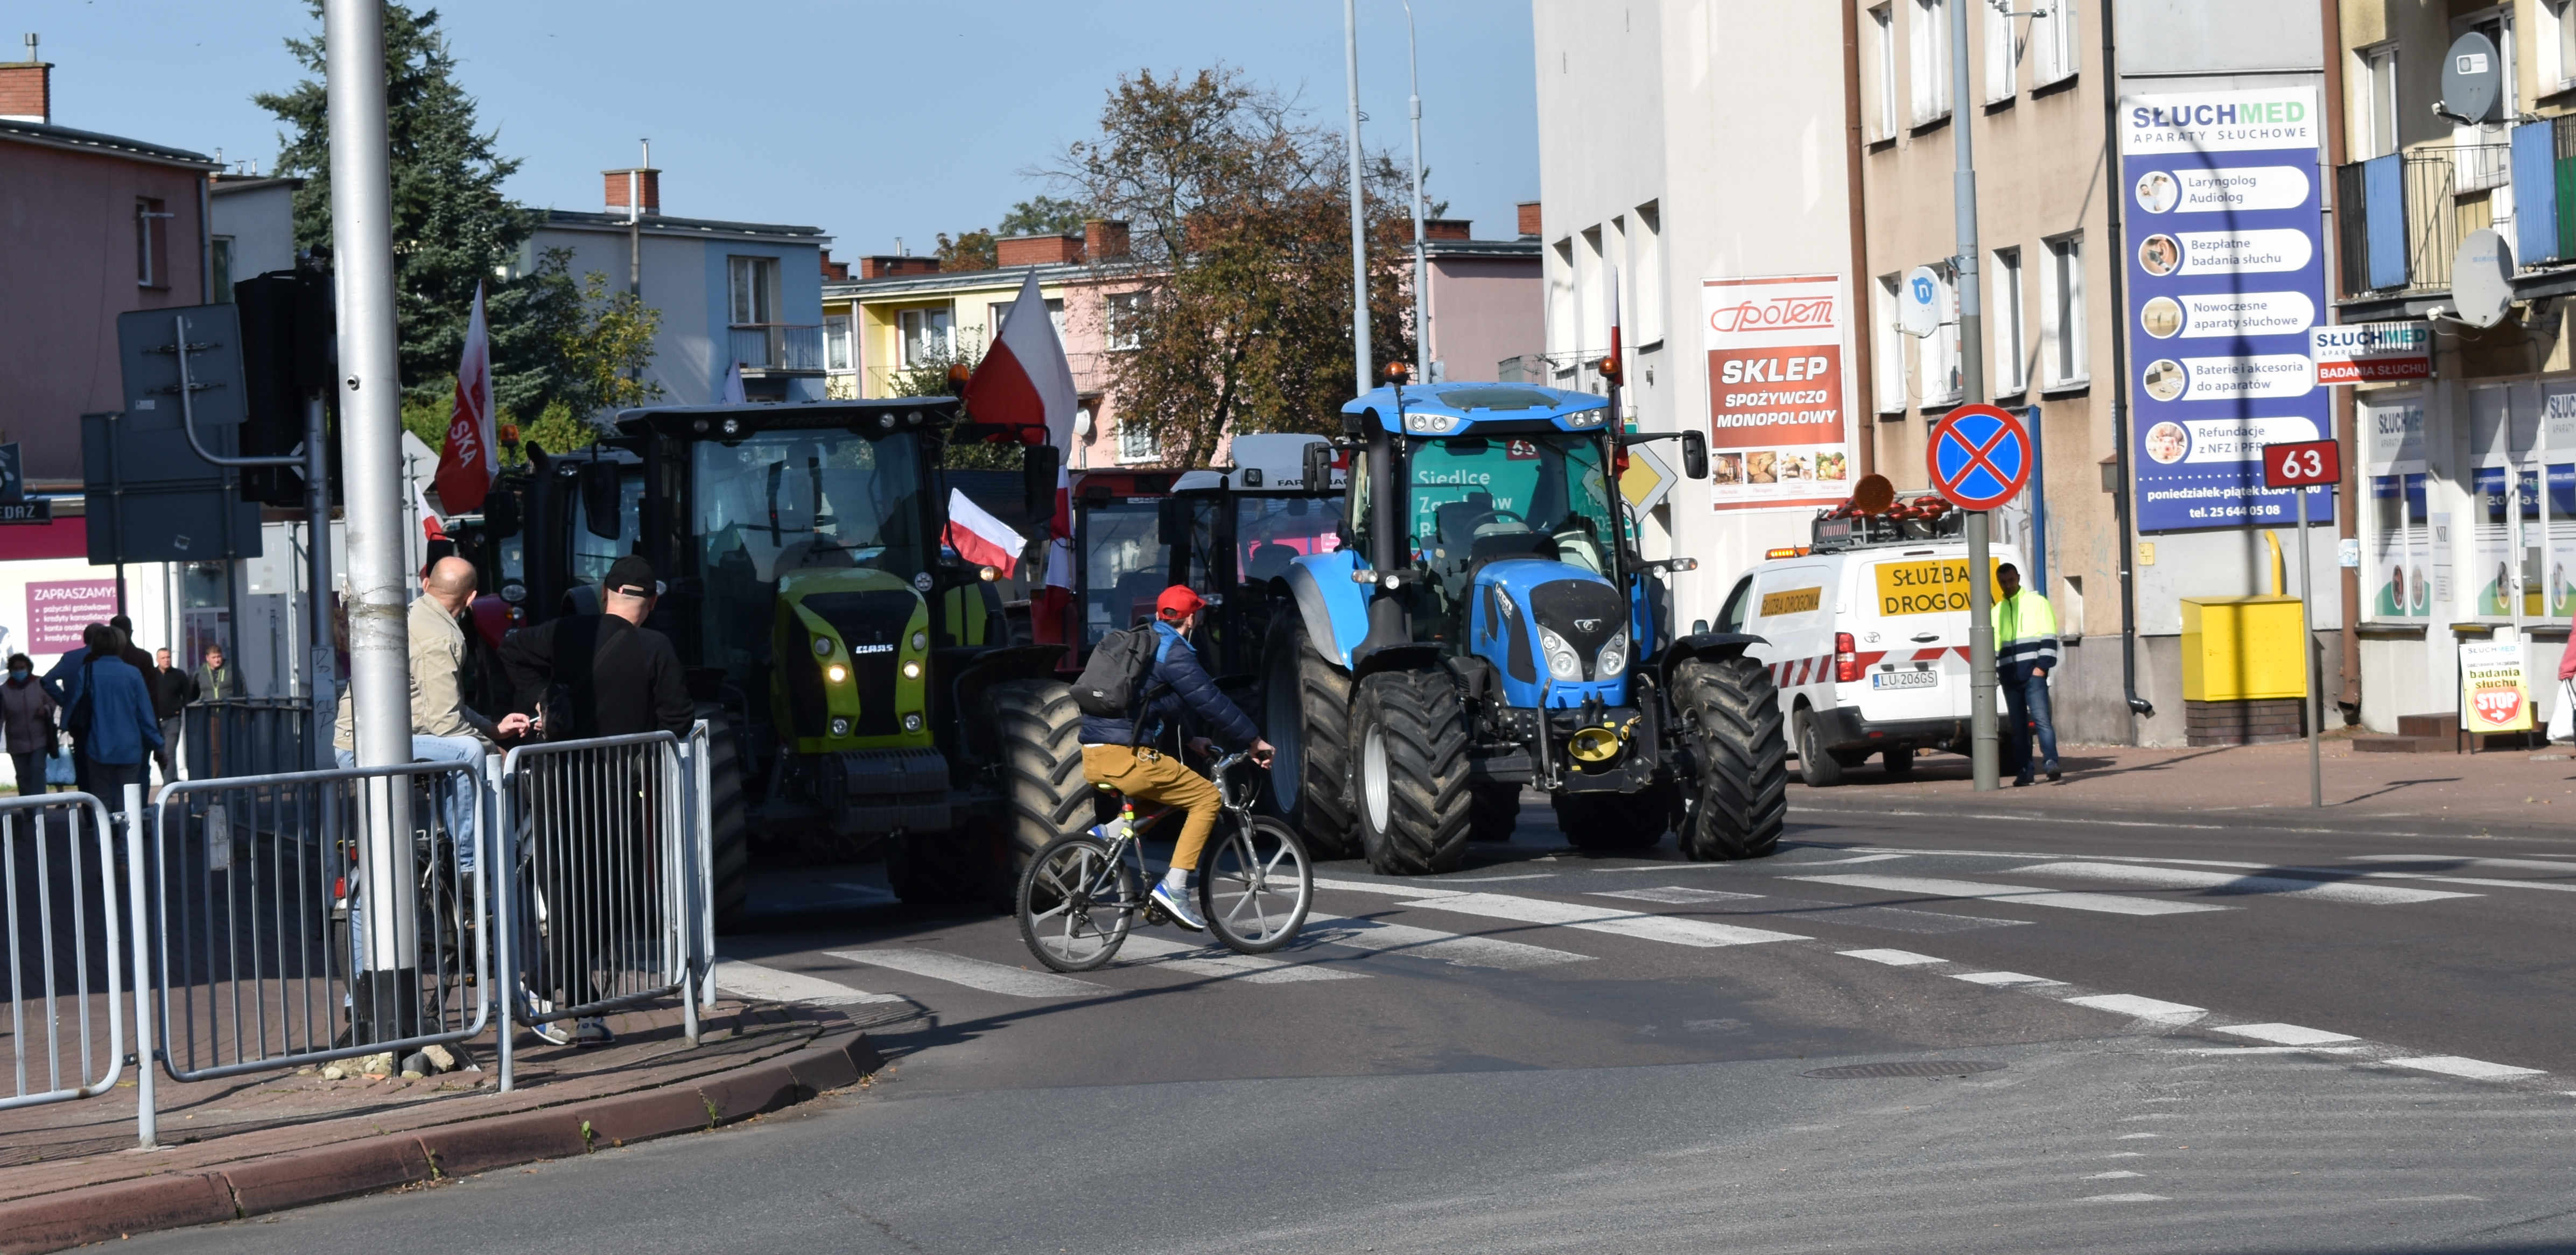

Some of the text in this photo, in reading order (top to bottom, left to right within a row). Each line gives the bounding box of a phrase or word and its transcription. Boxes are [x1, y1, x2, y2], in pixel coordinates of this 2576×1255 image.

[2132, 102, 2305, 129] SŁUCHMED
[2134, 128, 2307, 143] APARATY SŁUCHOWE
[2189, 176, 2256, 188] Laryngolog
[2189, 193, 2243, 204] Audiolog
[2192, 238, 2250, 250] Bezpłatne
[2192, 253, 2281, 266] badania słuchu
[2194, 301, 2267, 312] Nowoczesne
[2194, 316, 2298, 329] aparaty słuchowe
[2317, 329, 2427, 347] SŁUCHMED
[2322, 349, 2364, 357] APARATY
[1722, 356, 1828, 384] SKLEP
[2196, 365, 2237, 375] Baterie
[2248, 362, 2303, 373] akcesoria
[2320, 364, 2426, 378] BADANIA SŁUCHU
[2197, 379, 2271, 392] do aparatów
[1725, 390, 1827, 407] SPOŻYWCZO
[2550, 395, 2576, 419] SŁUC
[1717, 410, 1837, 428] MONOPOLOWY
[2199, 426, 2265, 438] Refundacje
[2199, 446, 2205, 454] z
[2208, 443, 2230, 453] NFZ
[2282, 450, 2322, 478] 63
[1419, 469, 1491, 485] Siedlce
[2147, 486, 2259, 502] poniedziałek-piątek
[2189, 505, 2280, 518] tel. 25 644 05 08
[1893, 562, 1970, 586] SŁUŻBA
[34, 586, 116, 601] ZAPRASZAMY!
[856, 644, 893, 653] CLAAS
[1881, 672, 1934, 686] LU 206GS
[2469, 667, 2521, 679] badania
[2475, 679, 2517, 689] słuchu
[2476, 692, 2517, 710] STOP
